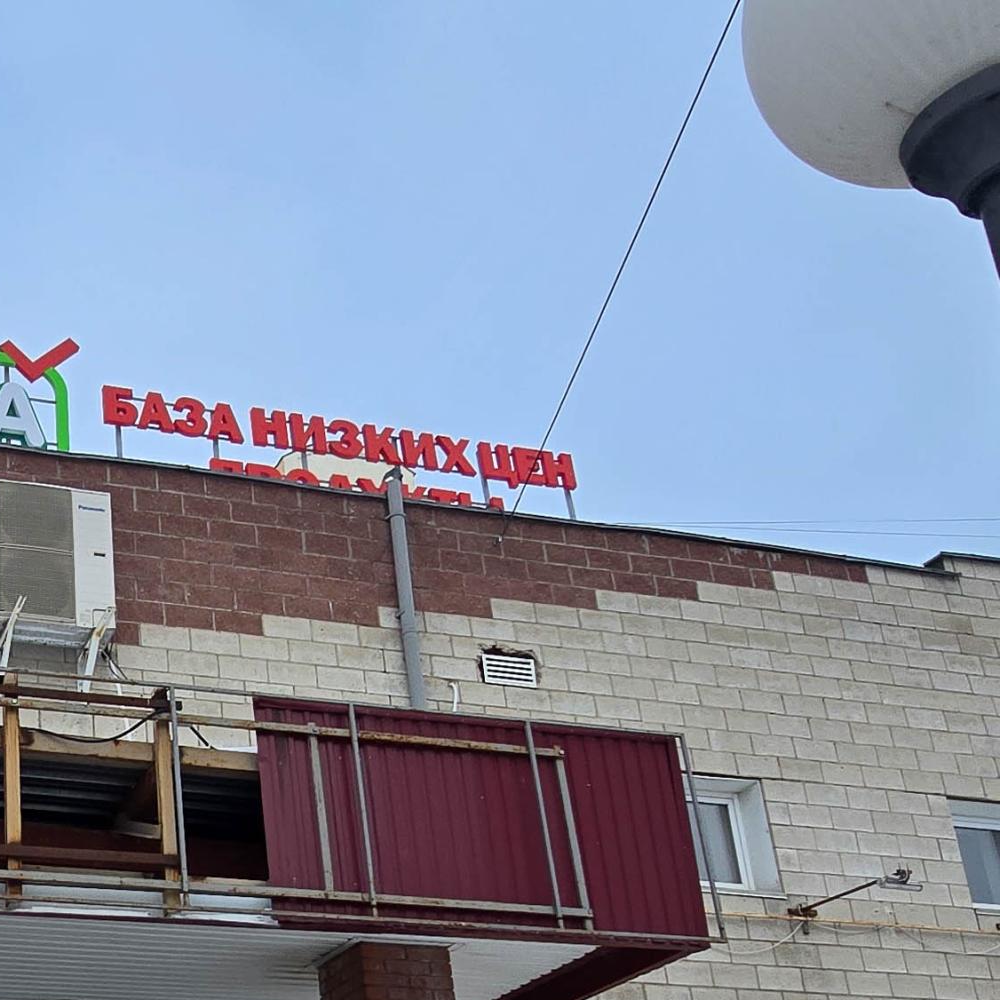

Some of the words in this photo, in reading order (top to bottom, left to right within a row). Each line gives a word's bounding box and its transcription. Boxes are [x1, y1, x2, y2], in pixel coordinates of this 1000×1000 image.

[102, 385, 244, 444] БАЗА
[250, 407, 477, 477] НИЗКИХ
[476, 441, 577, 491] ЦЕН
